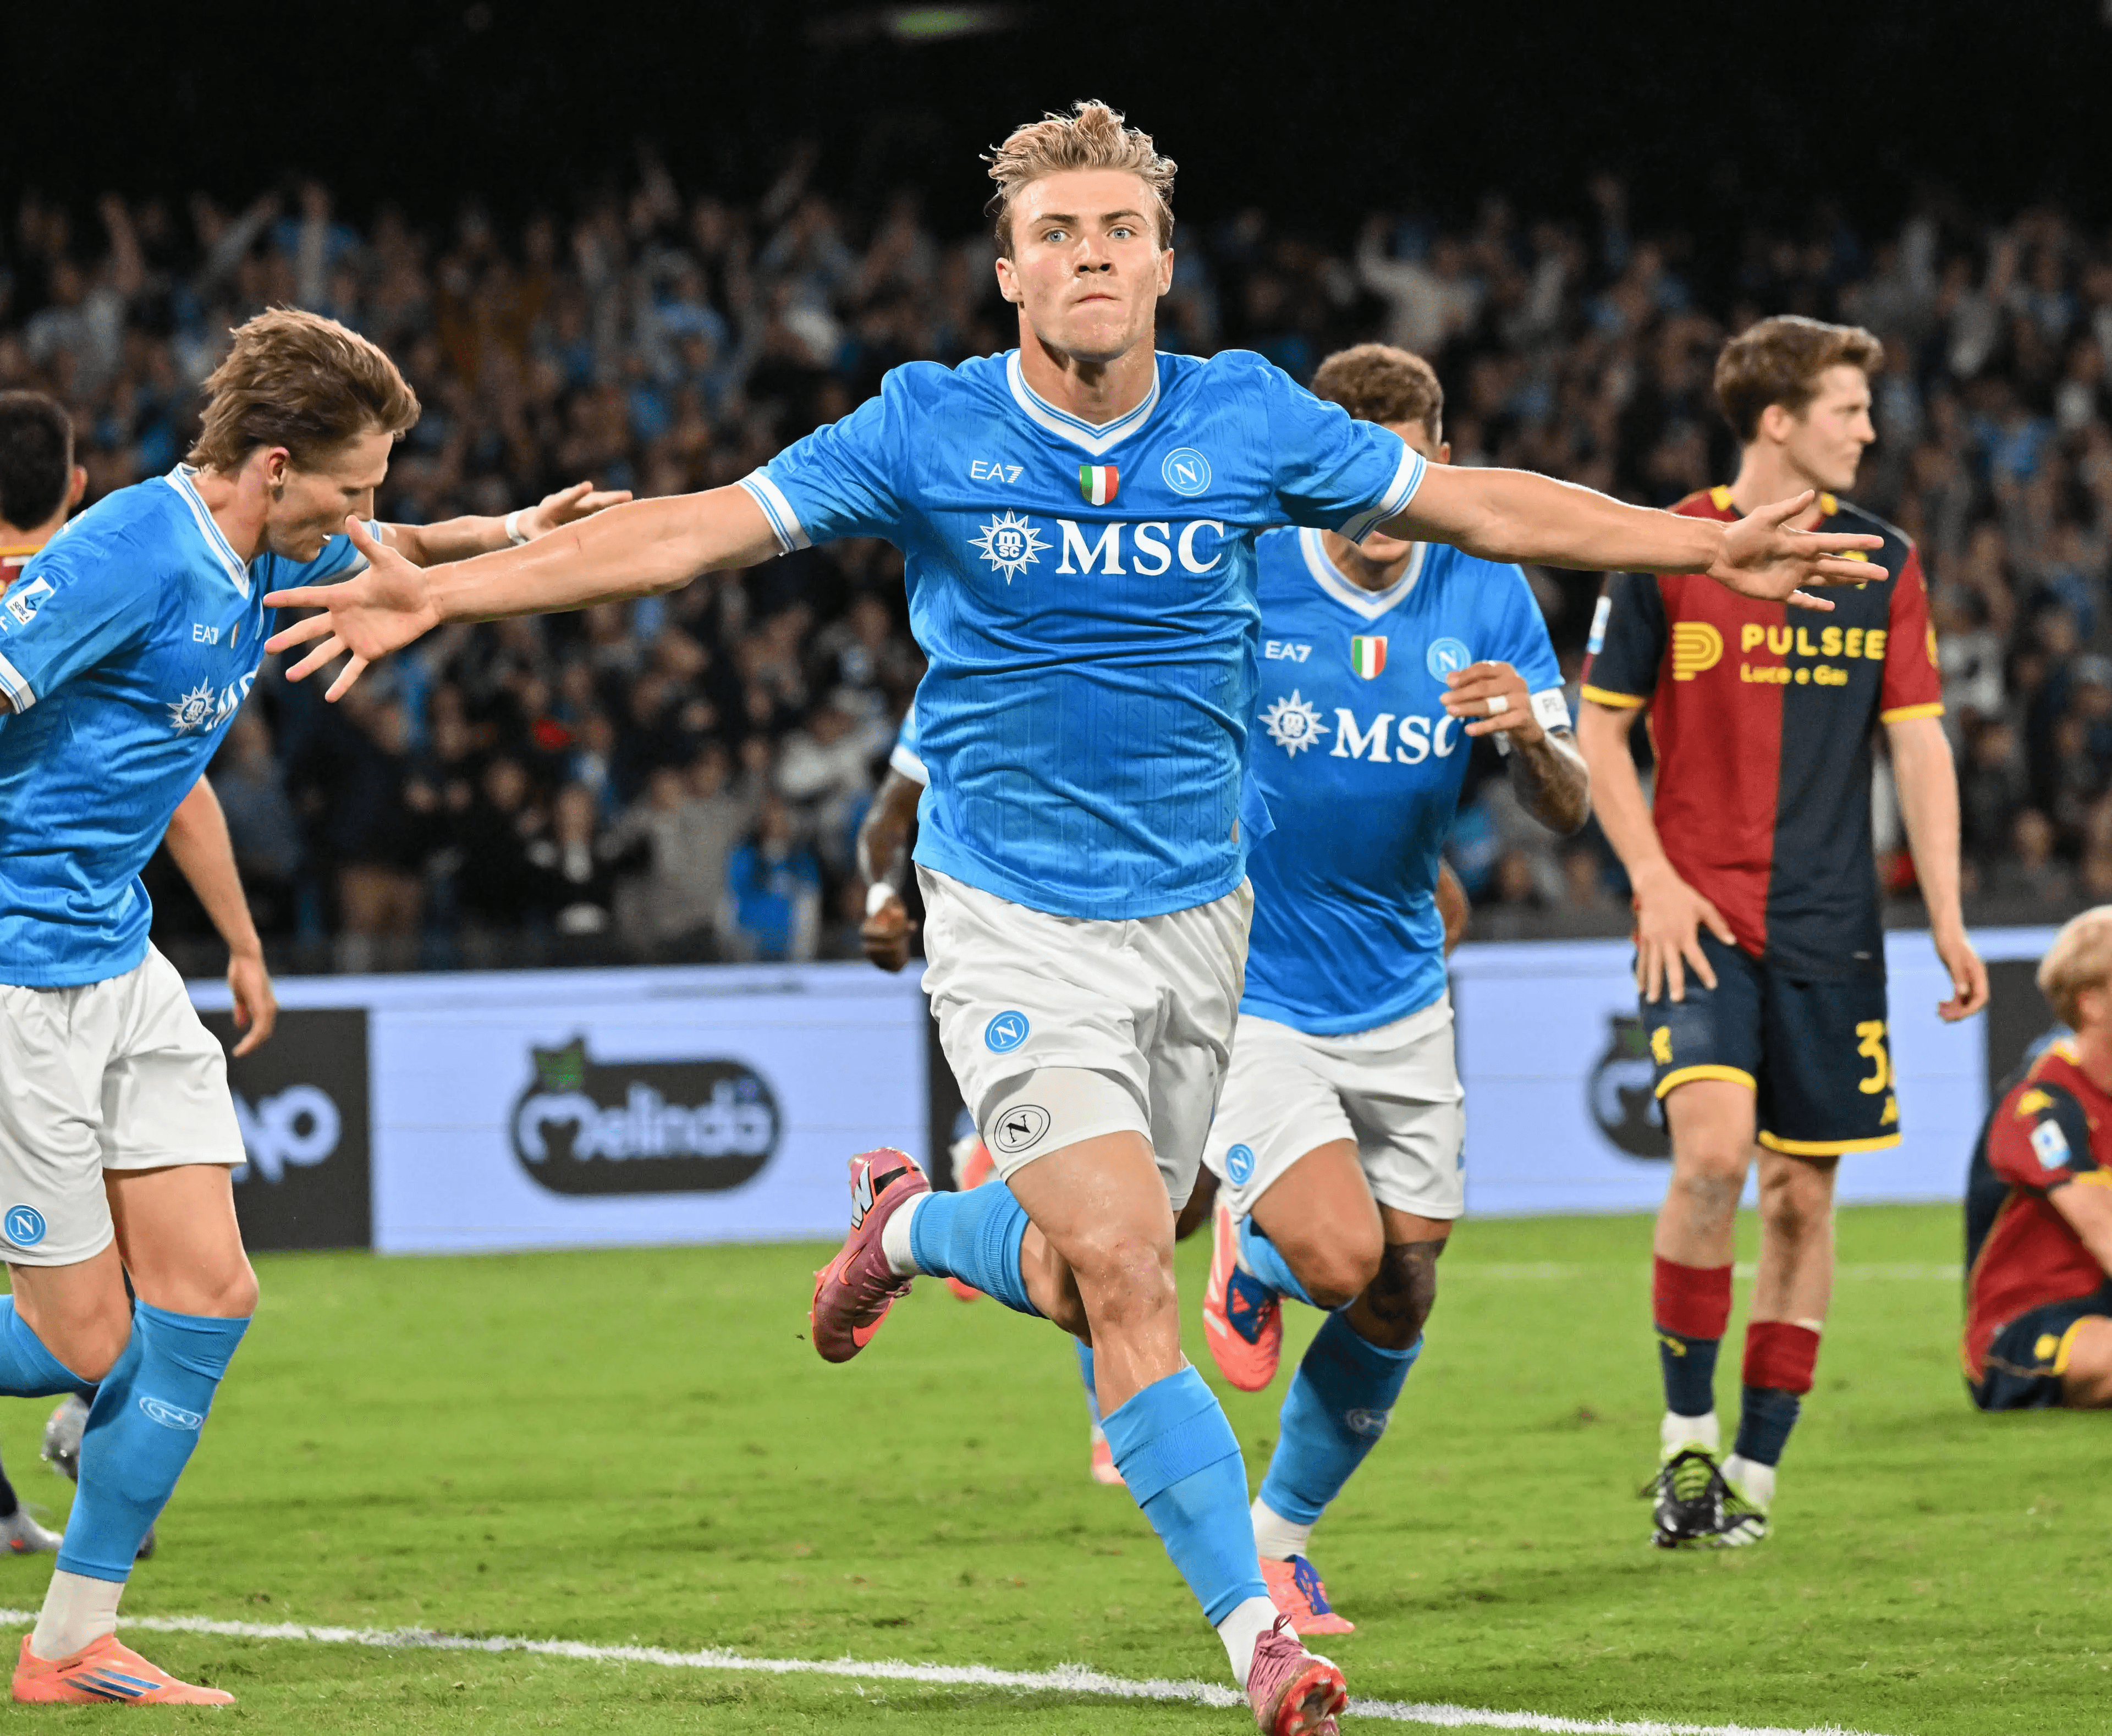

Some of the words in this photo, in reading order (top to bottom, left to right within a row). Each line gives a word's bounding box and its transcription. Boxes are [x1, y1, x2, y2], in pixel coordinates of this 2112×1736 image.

[970, 460, 1024, 483] EA7
[1174, 461, 1196, 485] N
[1055, 519, 1224, 576] MSC
[193, 623, 219, 644] EA7
[1741, 624, 1887, 660] PULSEE
[1265, 640, 1312, 663] EA7
[995, 1019, 1018, 1045] N
[1006, 1114, 1031, 1143] N
[14, 1215, 35, 1235] N
